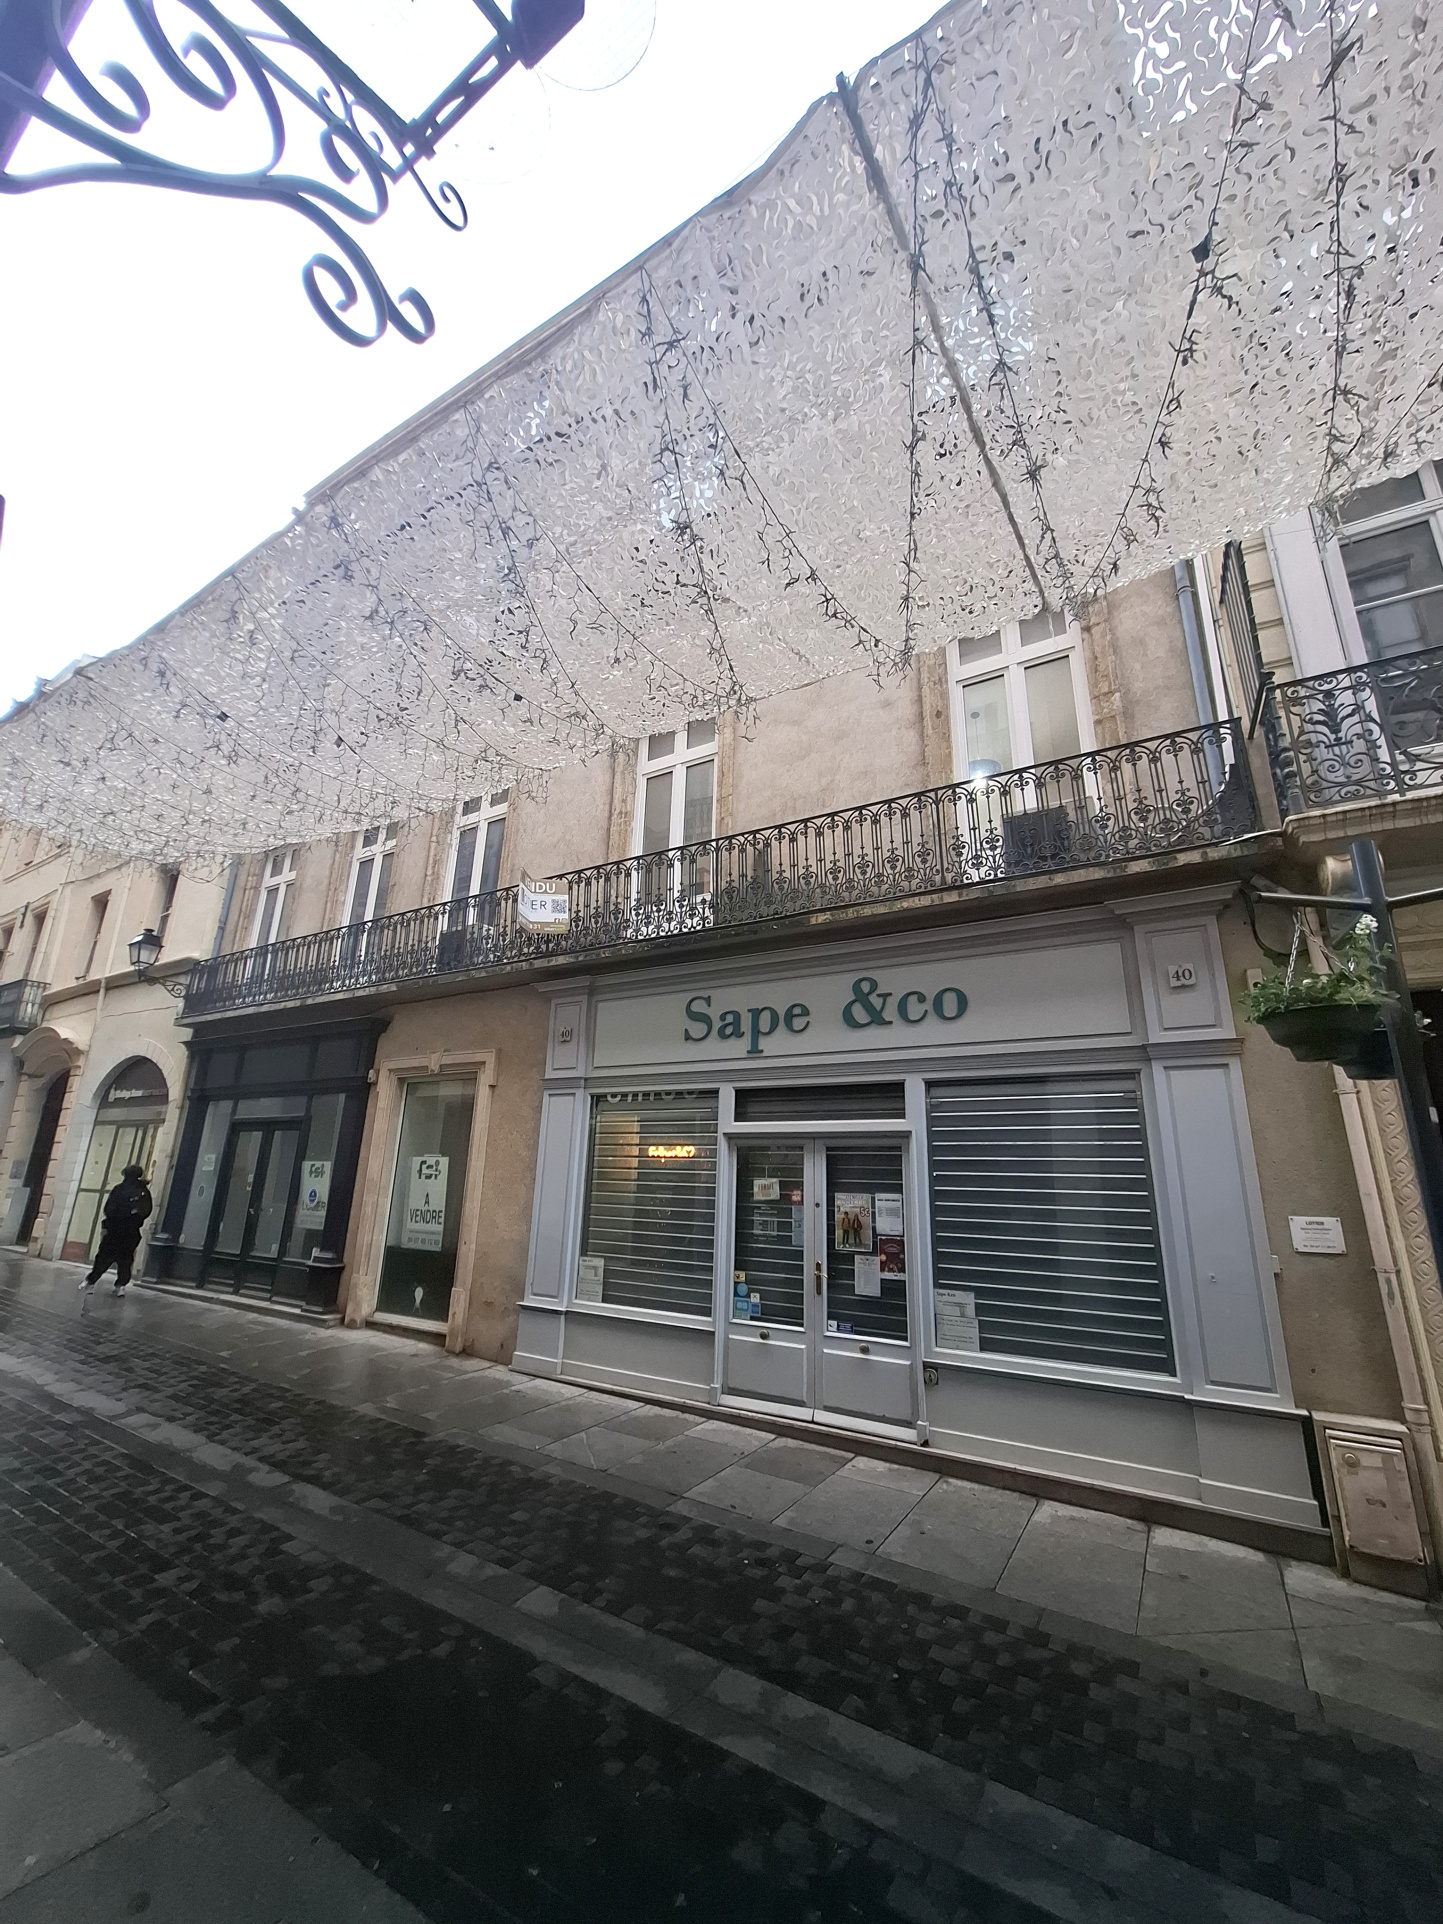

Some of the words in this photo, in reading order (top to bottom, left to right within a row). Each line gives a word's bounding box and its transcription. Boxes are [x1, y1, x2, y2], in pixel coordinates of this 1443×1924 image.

[1171, 968, 1193, 982] 40
[683, 994, 810, 1054] Sape
[842, 976, 968, 1028] &co
[560, 1029, 570, 1039] 40
[424, 1191, 430, 1207] A
[409, 1208, 443, 1225] VENDRE
